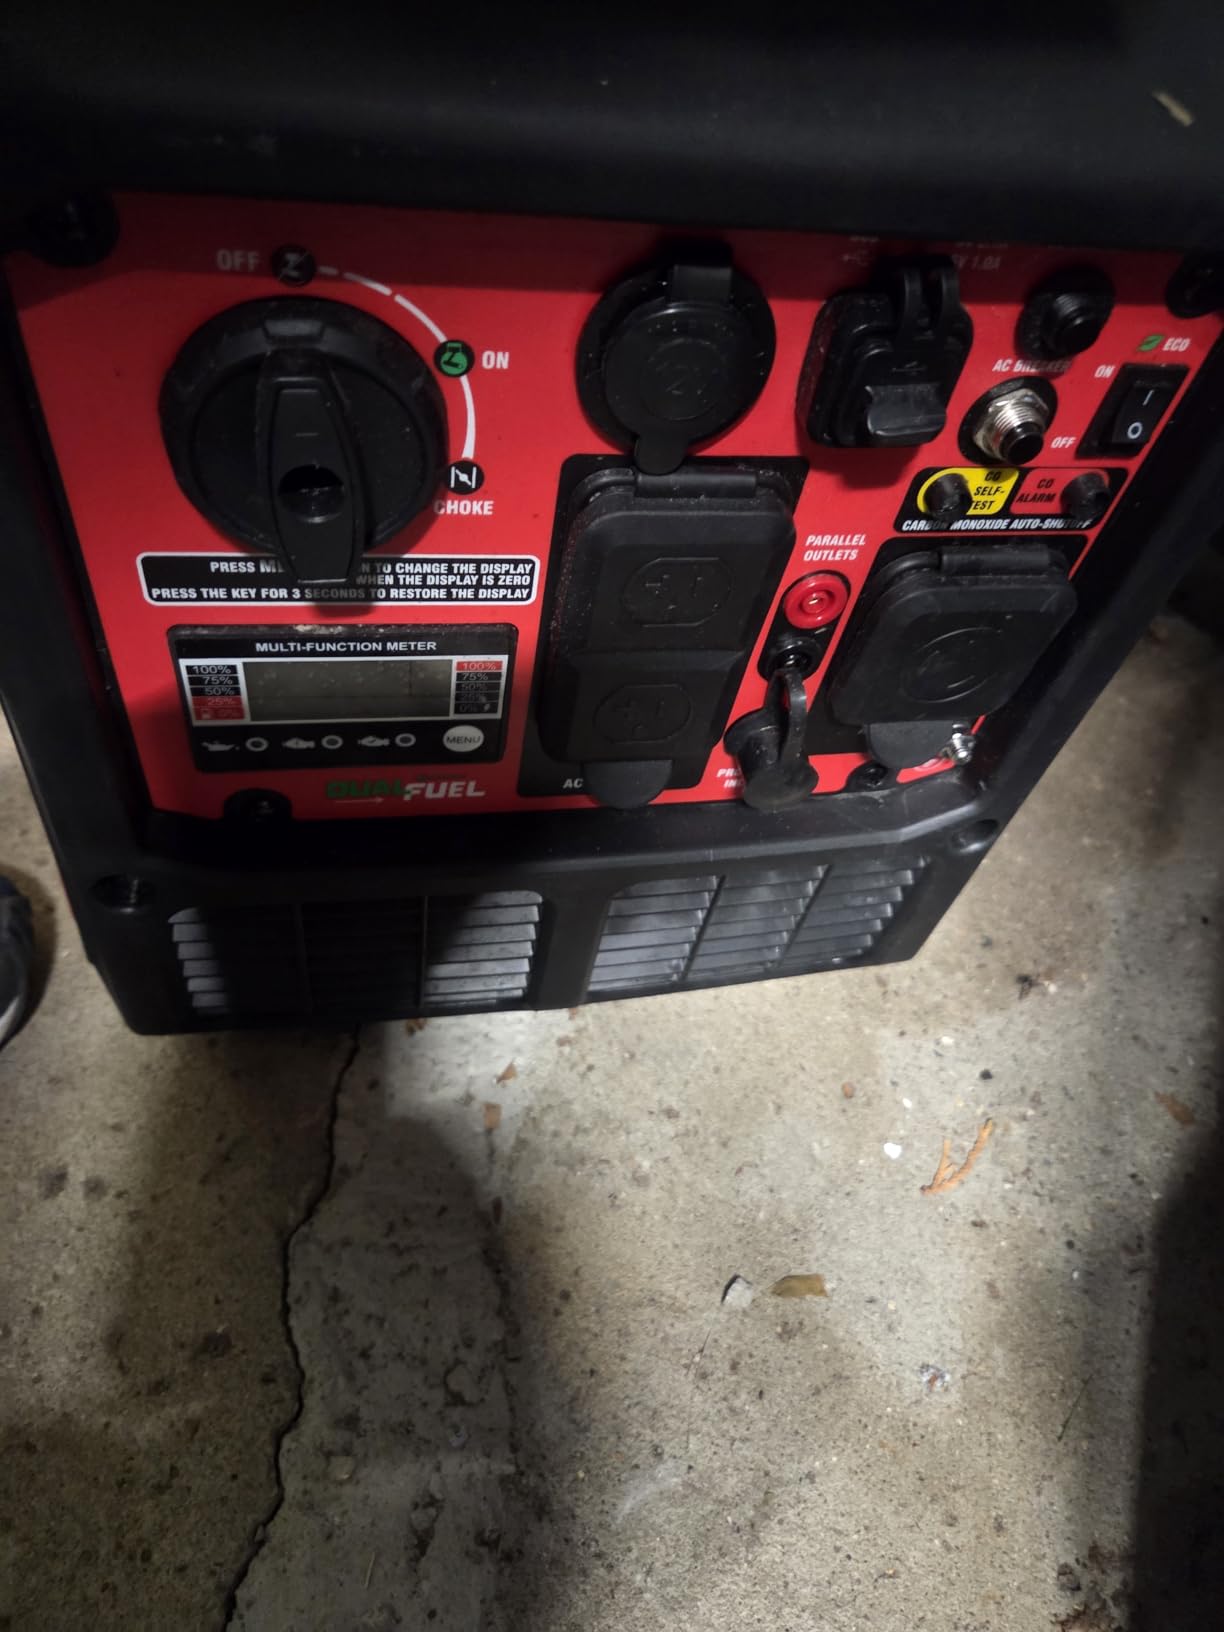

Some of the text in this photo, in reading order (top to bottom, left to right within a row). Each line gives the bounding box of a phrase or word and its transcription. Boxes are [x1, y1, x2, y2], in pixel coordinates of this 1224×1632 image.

[216, 248, 260, 272] OFF
[1162, 337, 1191, 351] ECO
[481, 350, 510, 370] ON
[992, 359, 1012, 372] AC
[1094, 365, 1116, 378] ON
[1050, 437, 1076, 449] OFF
[984, 471, 1001, 482] CO
[1037, 479, 1054, 489] CO
[973, 486, 1005, 497] SELF-
[1016, 493, 1057, 503] ALARM
[433, 499, 495, 516] CHOKE
[949, 518, 1010, 530] MONOXIDE
[805, 534, 867, 546] PARALLEL
[803, 549, 859, 561] OUTLETS
[209, 560, 256, 574] PRESS
[374, 562, 392, 574] TO
[395, 562, 449, 575] CHANGE
[451, 562, 477, 575] THE
[480, 562, 534, 575] DISPLAY
[398, 574, 423, 585] THE
[426, 574, 479, 585] DISPLAY
[482, 574, 494, 585] IS
[497, 574, 531, 585] ZERO
[151, 587, 530, 600] PRESS THE KEY FOR 3 SECONDS TO RESTORE THE DISPLAY
[256, 641, 437, 653] MULTI-FUNCTION METER
[192, 665, 232, 674] 100%
[463, 662, 497, 671] 100%
[203, 676, 233, 685] 75%
[462, 672, 489, 681] 75%
[205, 687, 236, 696] 50%
[446, 735, 481, 745] MENU
[562, 778, 584, 789] AC
[403, 780, 487, 801] FUEL
